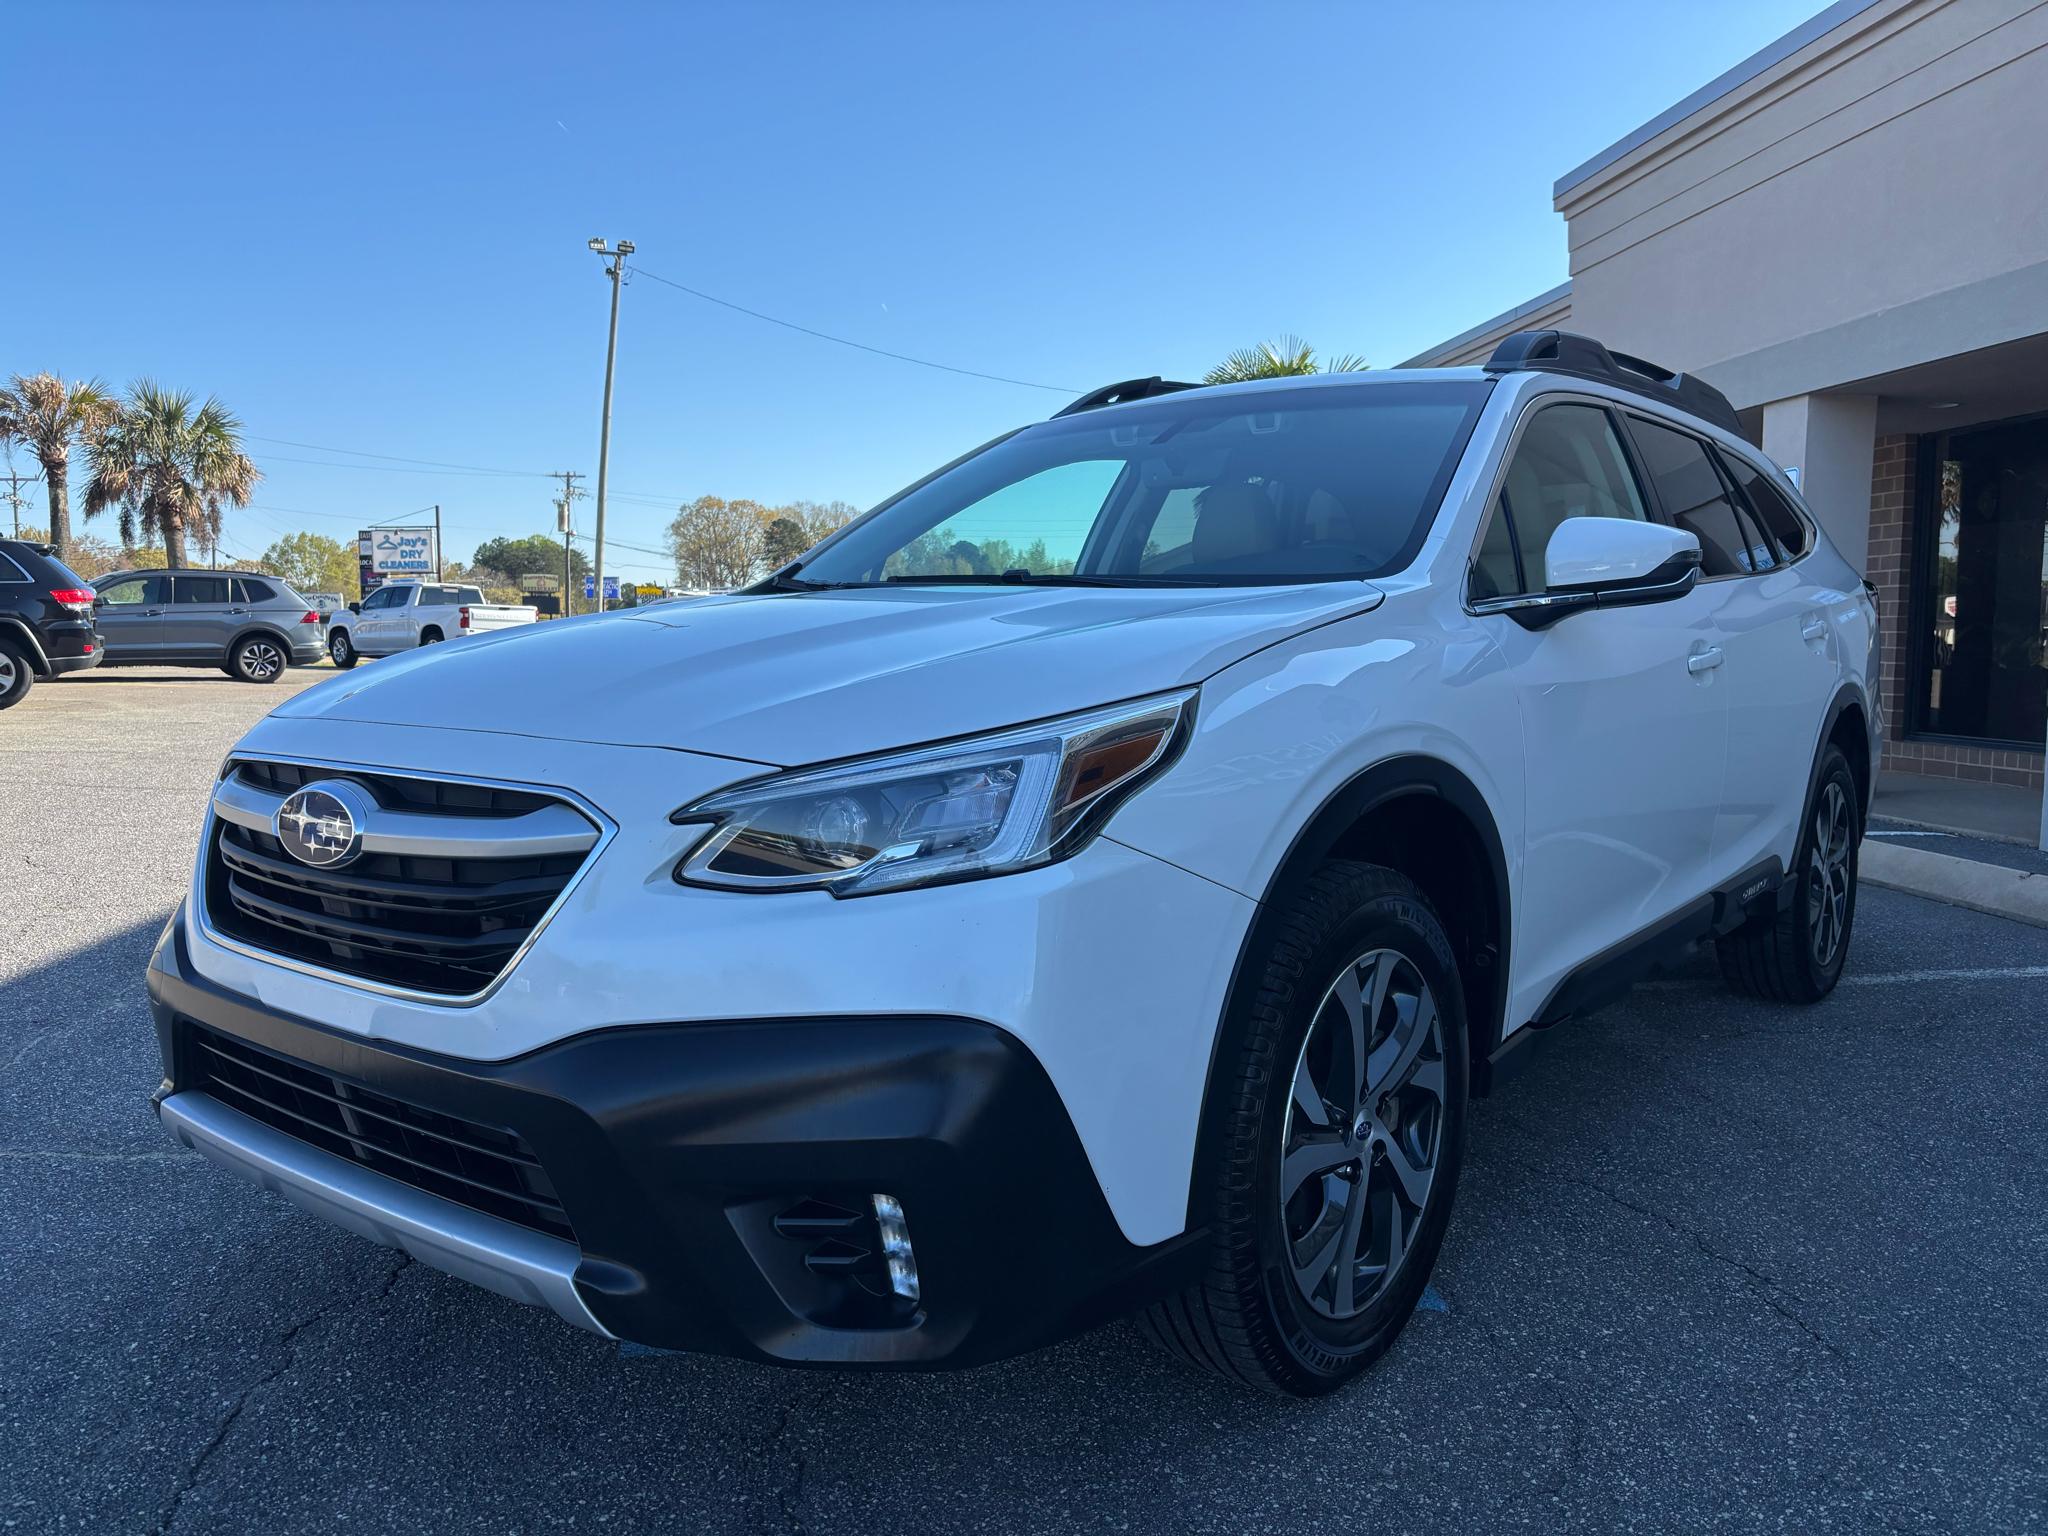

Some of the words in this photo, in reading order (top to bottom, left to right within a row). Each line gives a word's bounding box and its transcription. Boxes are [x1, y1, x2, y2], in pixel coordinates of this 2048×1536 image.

[397, 536, 428, 548] Jay's
[400, 549, 424, 559] DRY
[360, 559, 373, 567] LOCA
[378, 560, 430, 570] CLEANERS
